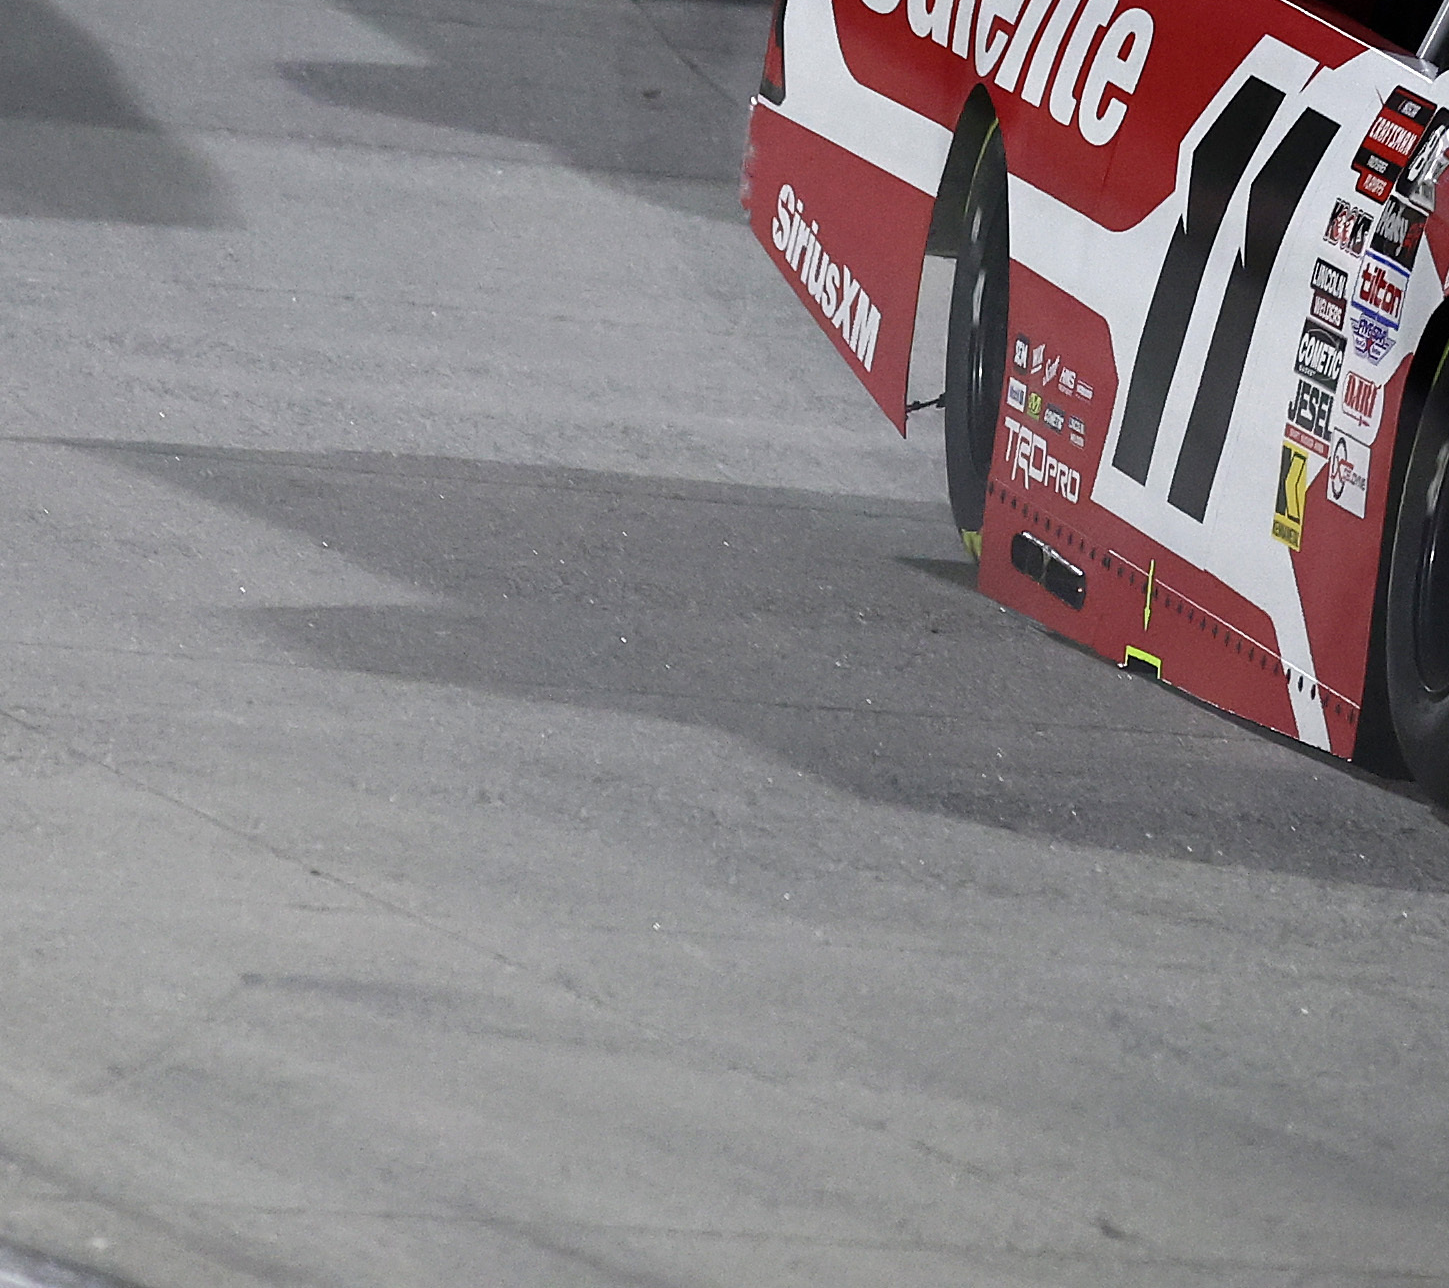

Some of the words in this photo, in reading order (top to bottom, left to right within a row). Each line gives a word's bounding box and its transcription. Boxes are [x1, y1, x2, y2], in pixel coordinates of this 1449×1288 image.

[1368, 115, 1418, 157] CRAFTSMAN
[771, 183, 883, 374] SiriusXM
[1112, 73, 1343, 525] 11
[1312, 261, 1348, 299] LINCOLN
[1359, 261, 1404, 319] tilton
[1298, 331, 1344, 381] COMETIC
[1287, 378, 1334, 442] JESEL
